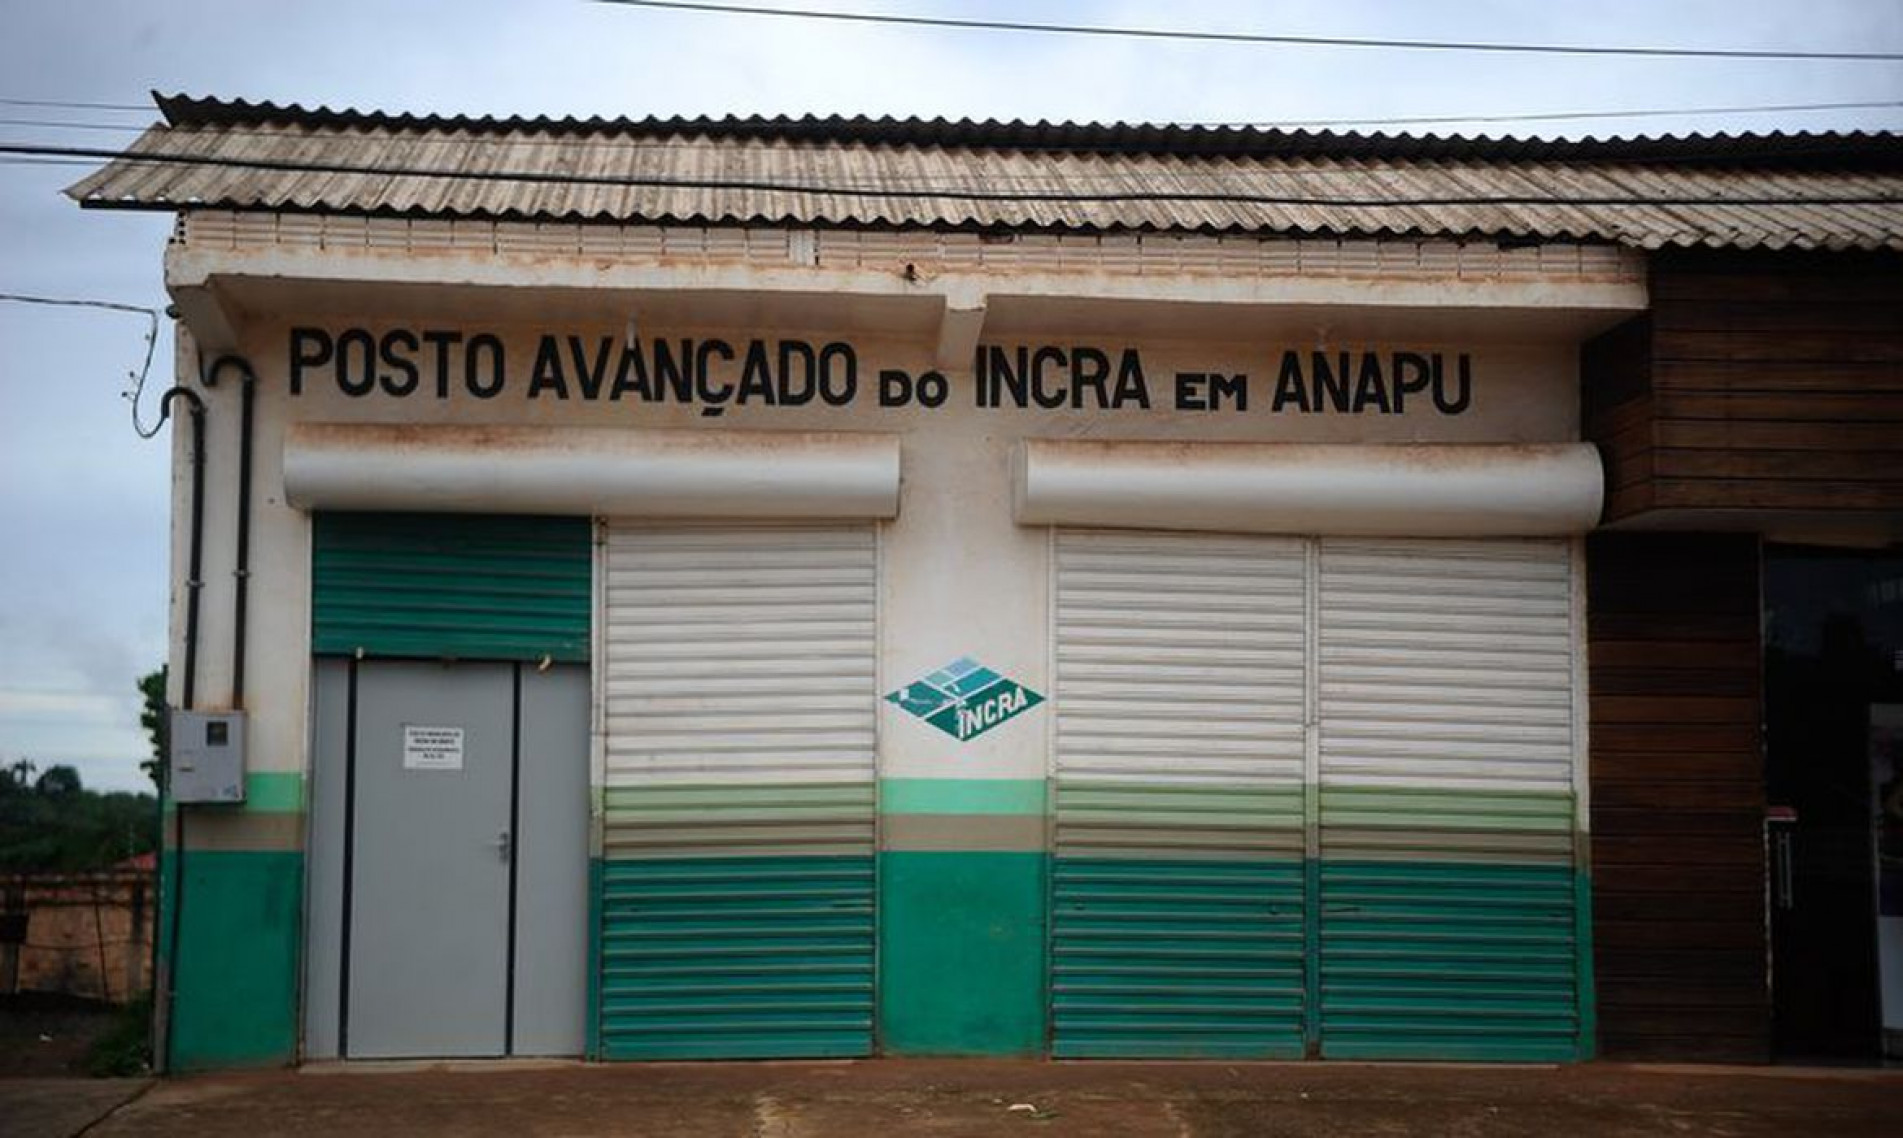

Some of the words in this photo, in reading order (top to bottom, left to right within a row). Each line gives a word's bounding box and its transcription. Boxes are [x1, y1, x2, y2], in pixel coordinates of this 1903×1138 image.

[290, 327, 505, 399] POSTO
[528, 335, 857, 416] AVANÇADO
[879, 369, 949, 407] DO
[976, 345, 1150, 409] INCRA
[1175, 372, 1247, 411] EM
[1272, 350, 1471, 414] ANAPU
[957, 687, 1028, 739] INCRA
